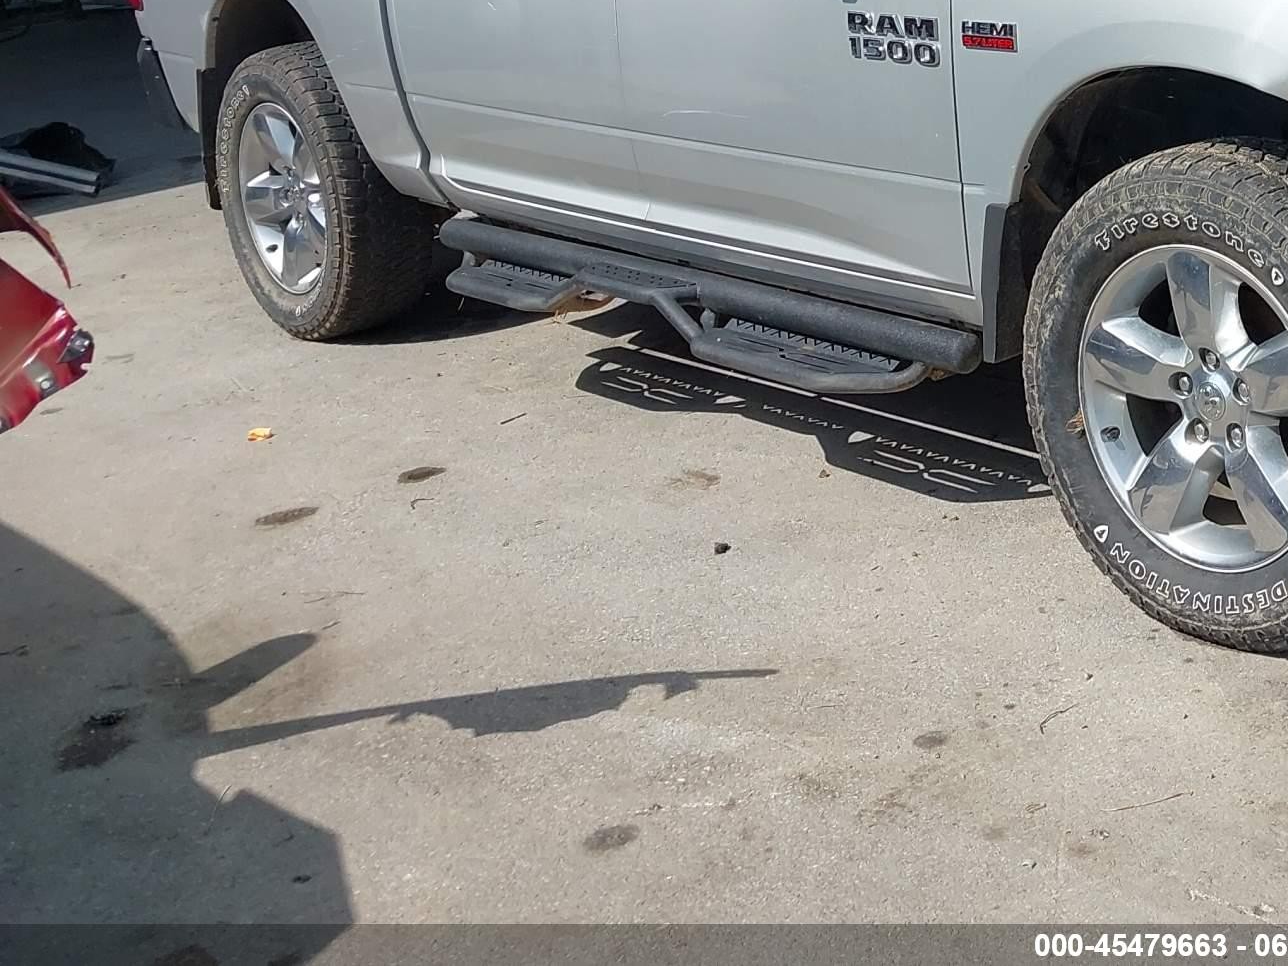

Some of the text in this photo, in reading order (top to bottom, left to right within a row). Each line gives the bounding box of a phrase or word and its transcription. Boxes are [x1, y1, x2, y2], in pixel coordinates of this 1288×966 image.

[847, 10, 939, 41] RAM
[961, 20, 1017, 37] HEMI
[848, 36, 941, 67] 1500
[1094, 212, 1264, 268] Firestone
[1110, 542, 1288, 614] DESTINATION
